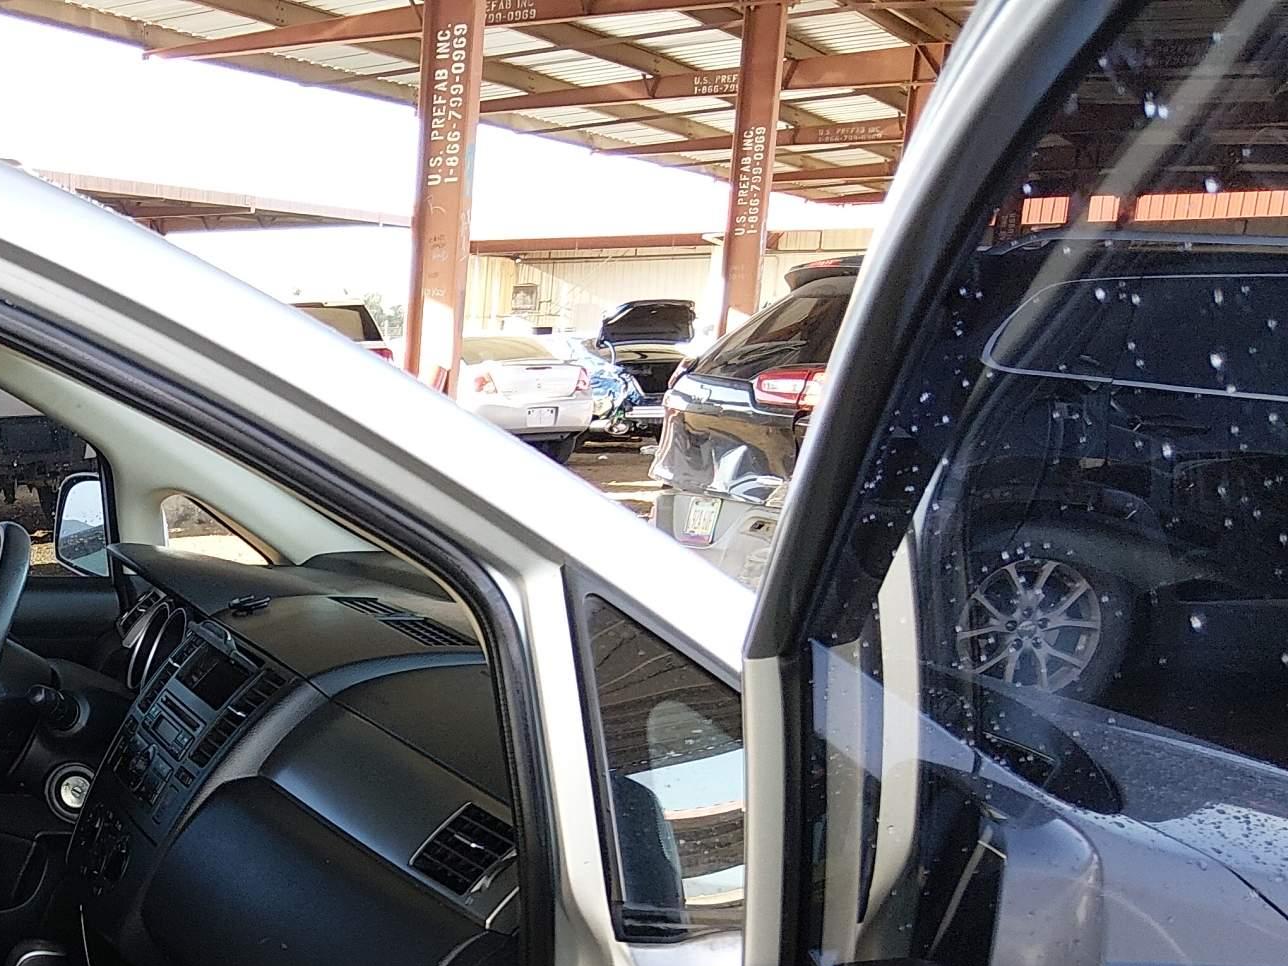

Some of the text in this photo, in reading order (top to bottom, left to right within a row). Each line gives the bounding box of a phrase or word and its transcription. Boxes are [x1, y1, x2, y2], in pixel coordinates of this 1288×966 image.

[428, 23, 452, 186] U.S. PREFAB INC.
[444, 23, 468, 183] 1-866-799-0969
[737, 156, 752, 205] PREFAB
[747, 126, 767, 234] 1-866-799-0969
